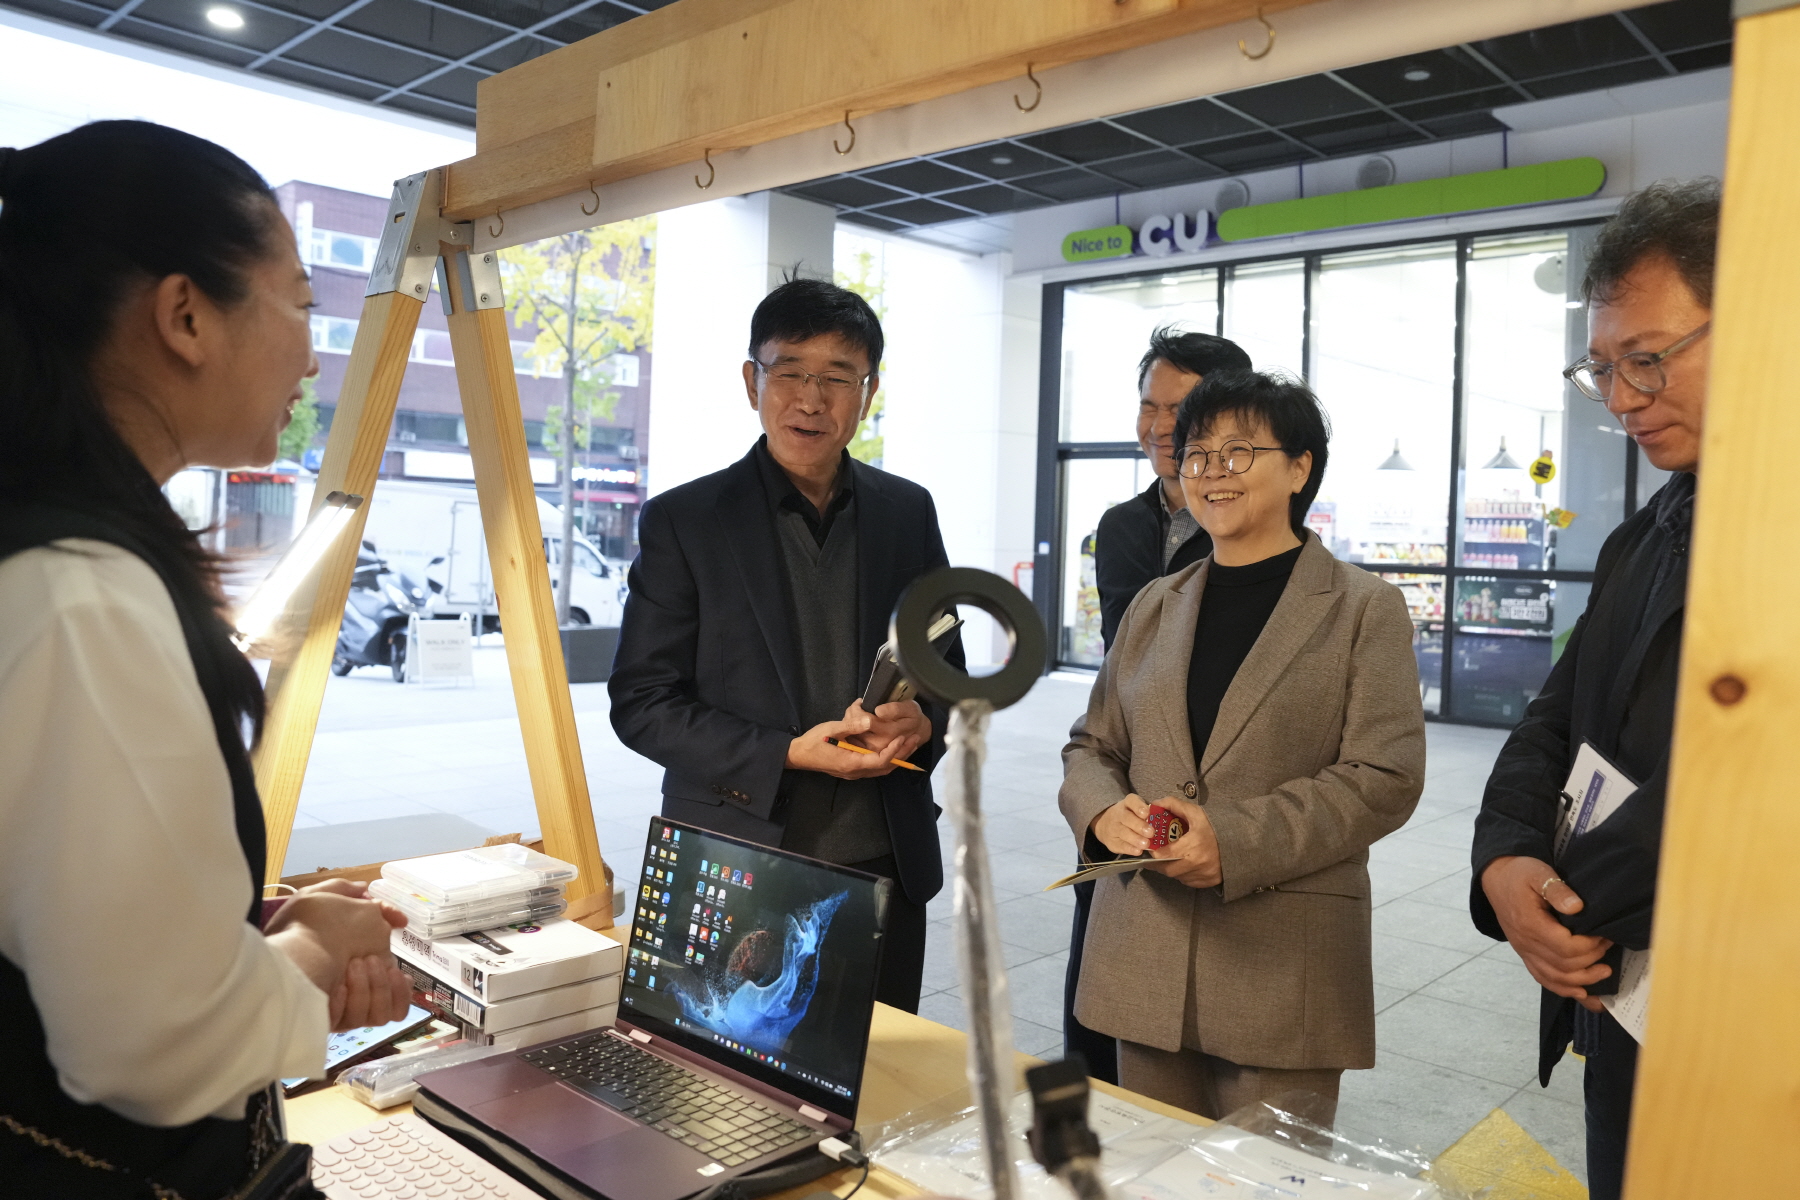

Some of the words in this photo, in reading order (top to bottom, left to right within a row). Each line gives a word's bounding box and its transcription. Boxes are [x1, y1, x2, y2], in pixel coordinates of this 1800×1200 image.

[1071, 239, 1103, 254] Nice
[1108, 237, 1122, 249] to
[1139, 209, 1209, 256] CU
[464, 968, 471, 982] 12
